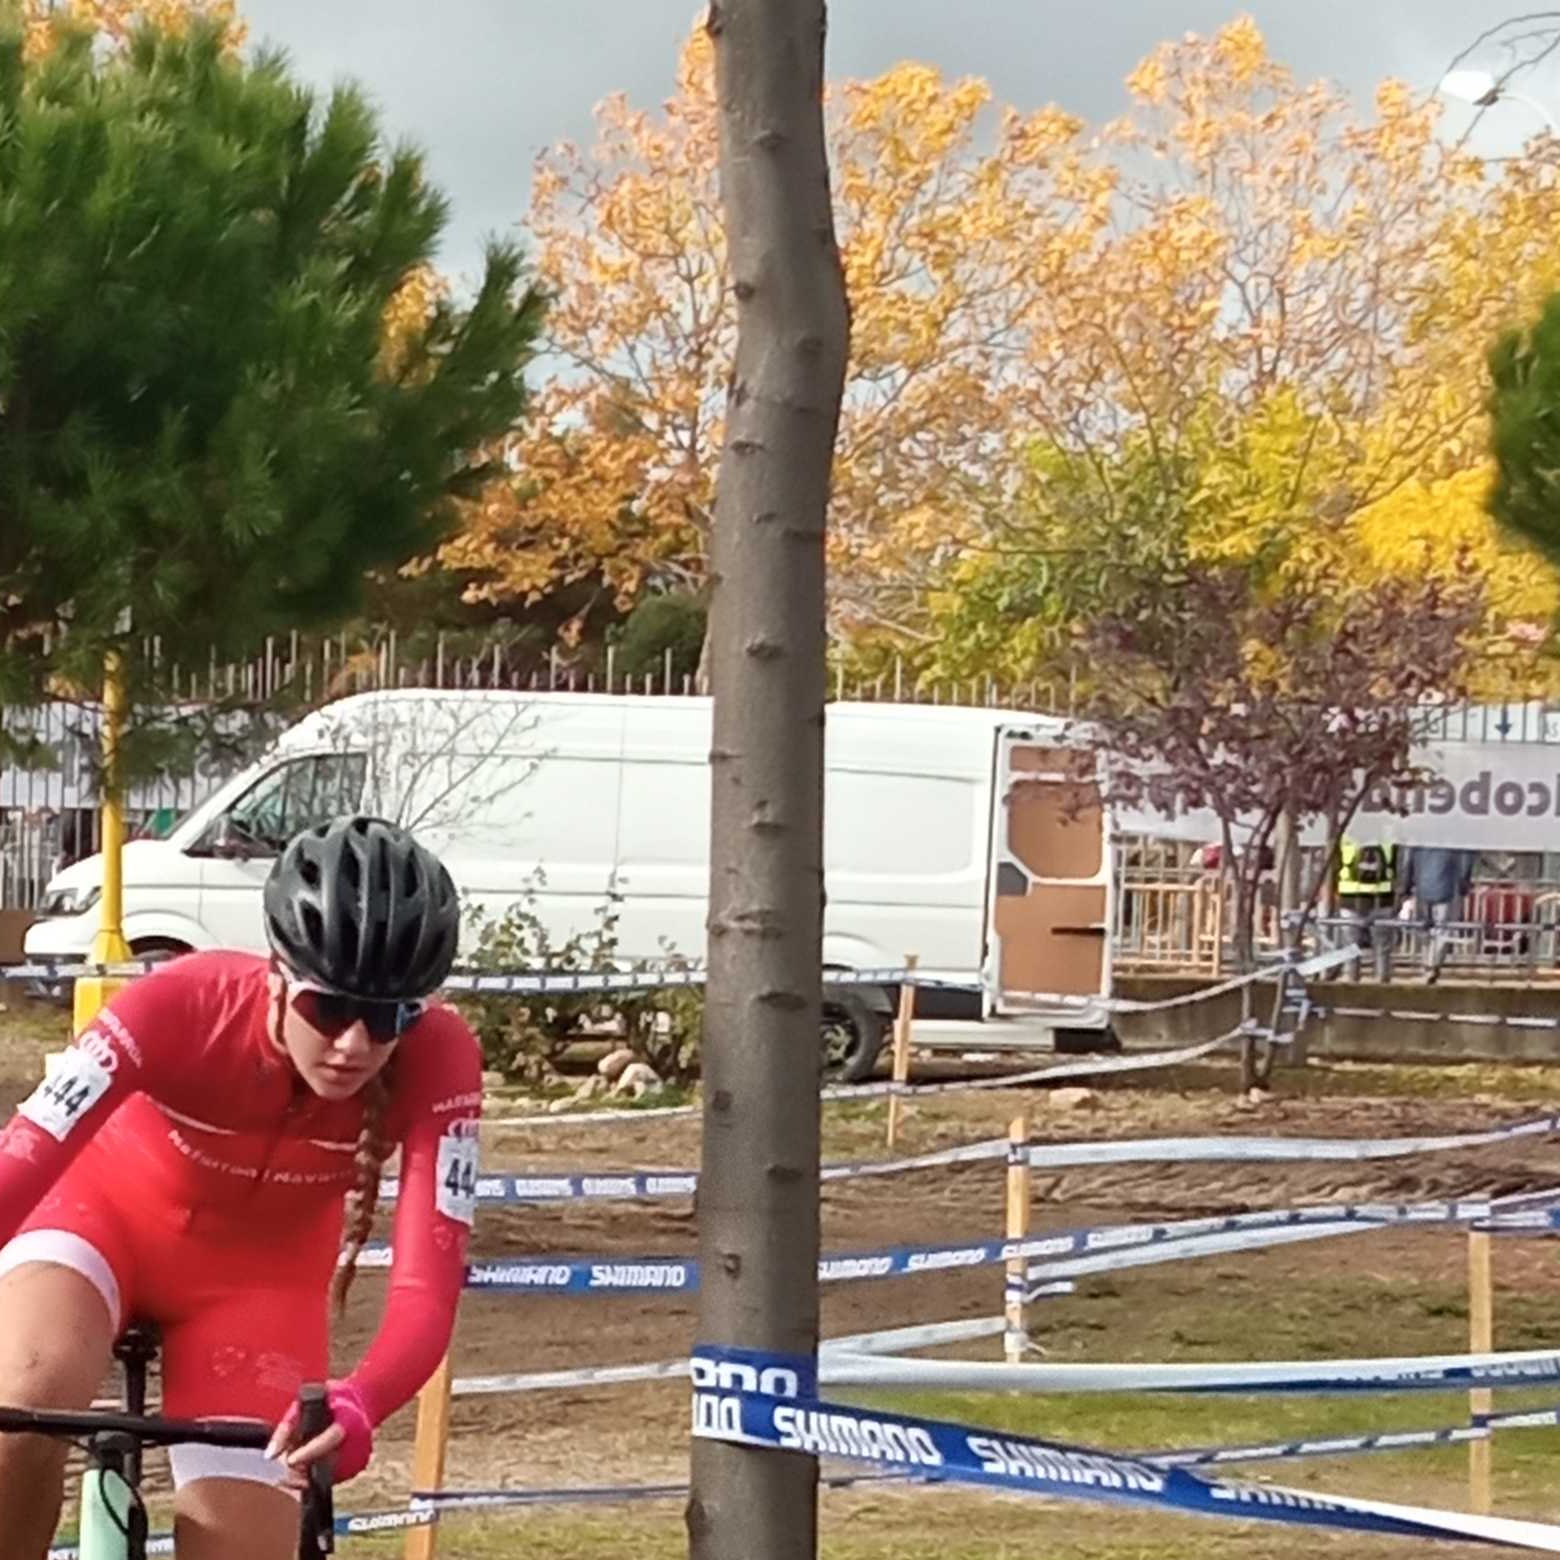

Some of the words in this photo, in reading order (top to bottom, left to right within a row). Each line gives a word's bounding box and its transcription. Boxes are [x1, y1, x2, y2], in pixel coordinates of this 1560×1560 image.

[469, 1264, 571, 1286] SHIMANO
[589, 1263, 685, 1288] SHIMANO
[773, 1405, 945, 1466] SHIMANO
[965, 1435, 1165, 1491] SHIMANO
